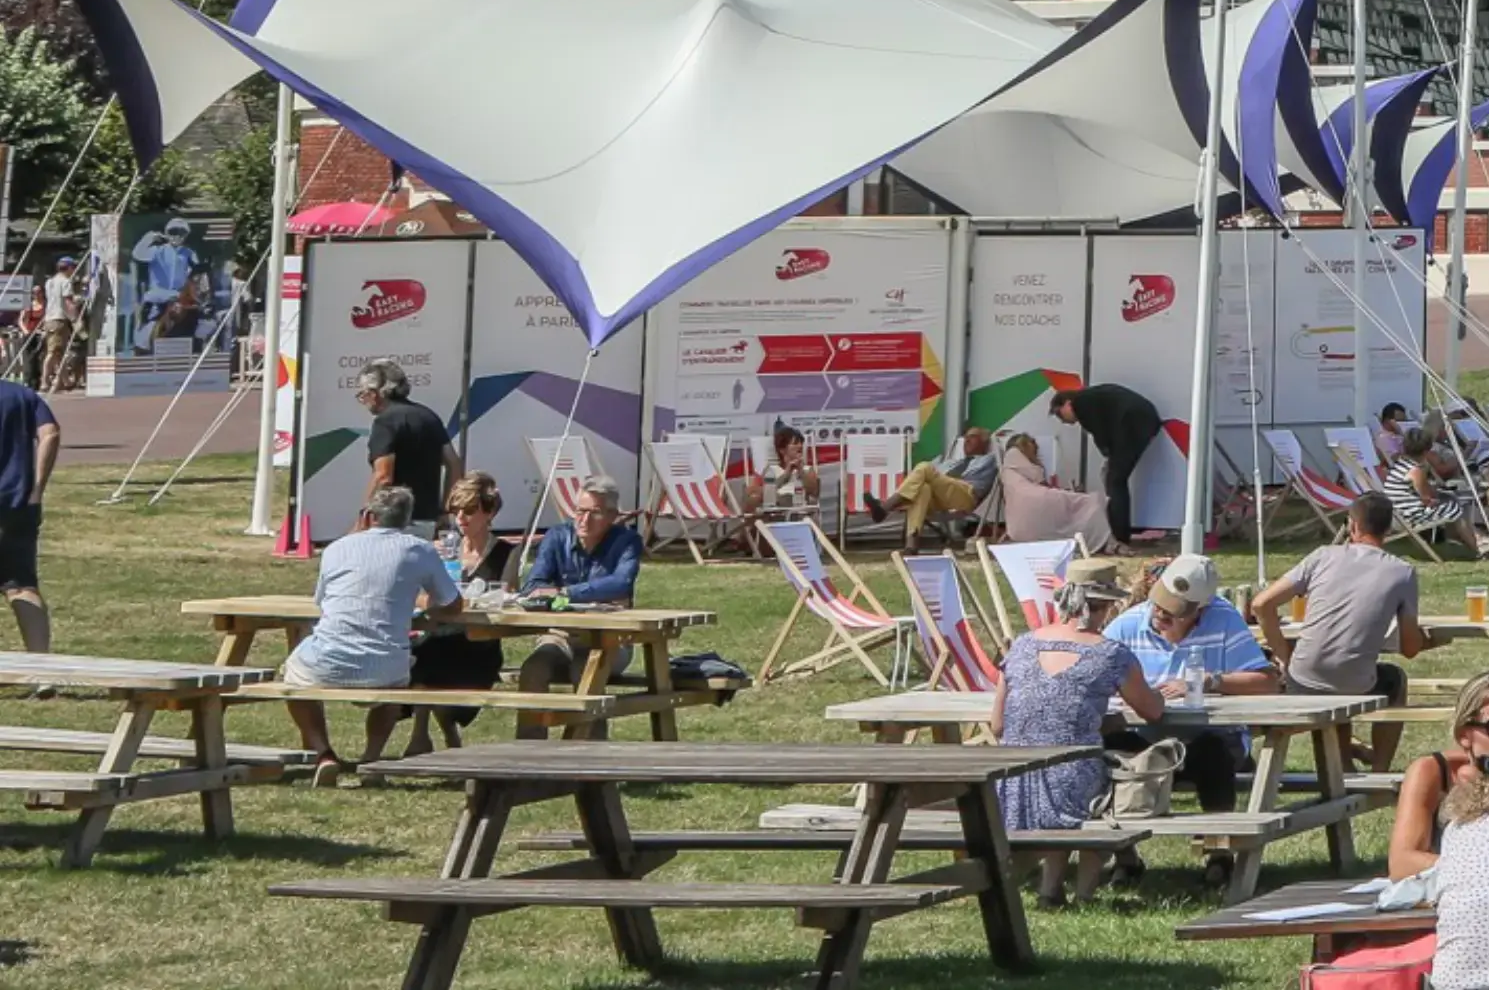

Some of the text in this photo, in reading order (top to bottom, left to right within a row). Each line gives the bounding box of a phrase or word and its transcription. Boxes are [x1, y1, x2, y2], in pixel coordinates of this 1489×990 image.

[1012, 273, 1047, 286] VENEZ
[376, 295, 398, 307] EASY
[514, 295, 565, 308] APPRE
[994, 294, 1064, 306] RENCONTRER
[378, 299, 414, 317] RACING
[526, 314, 580, 328] À PARI
[995, 314, 1061, 326] NOS COACHS
[338, 352, 433, 368] COMNDRE
